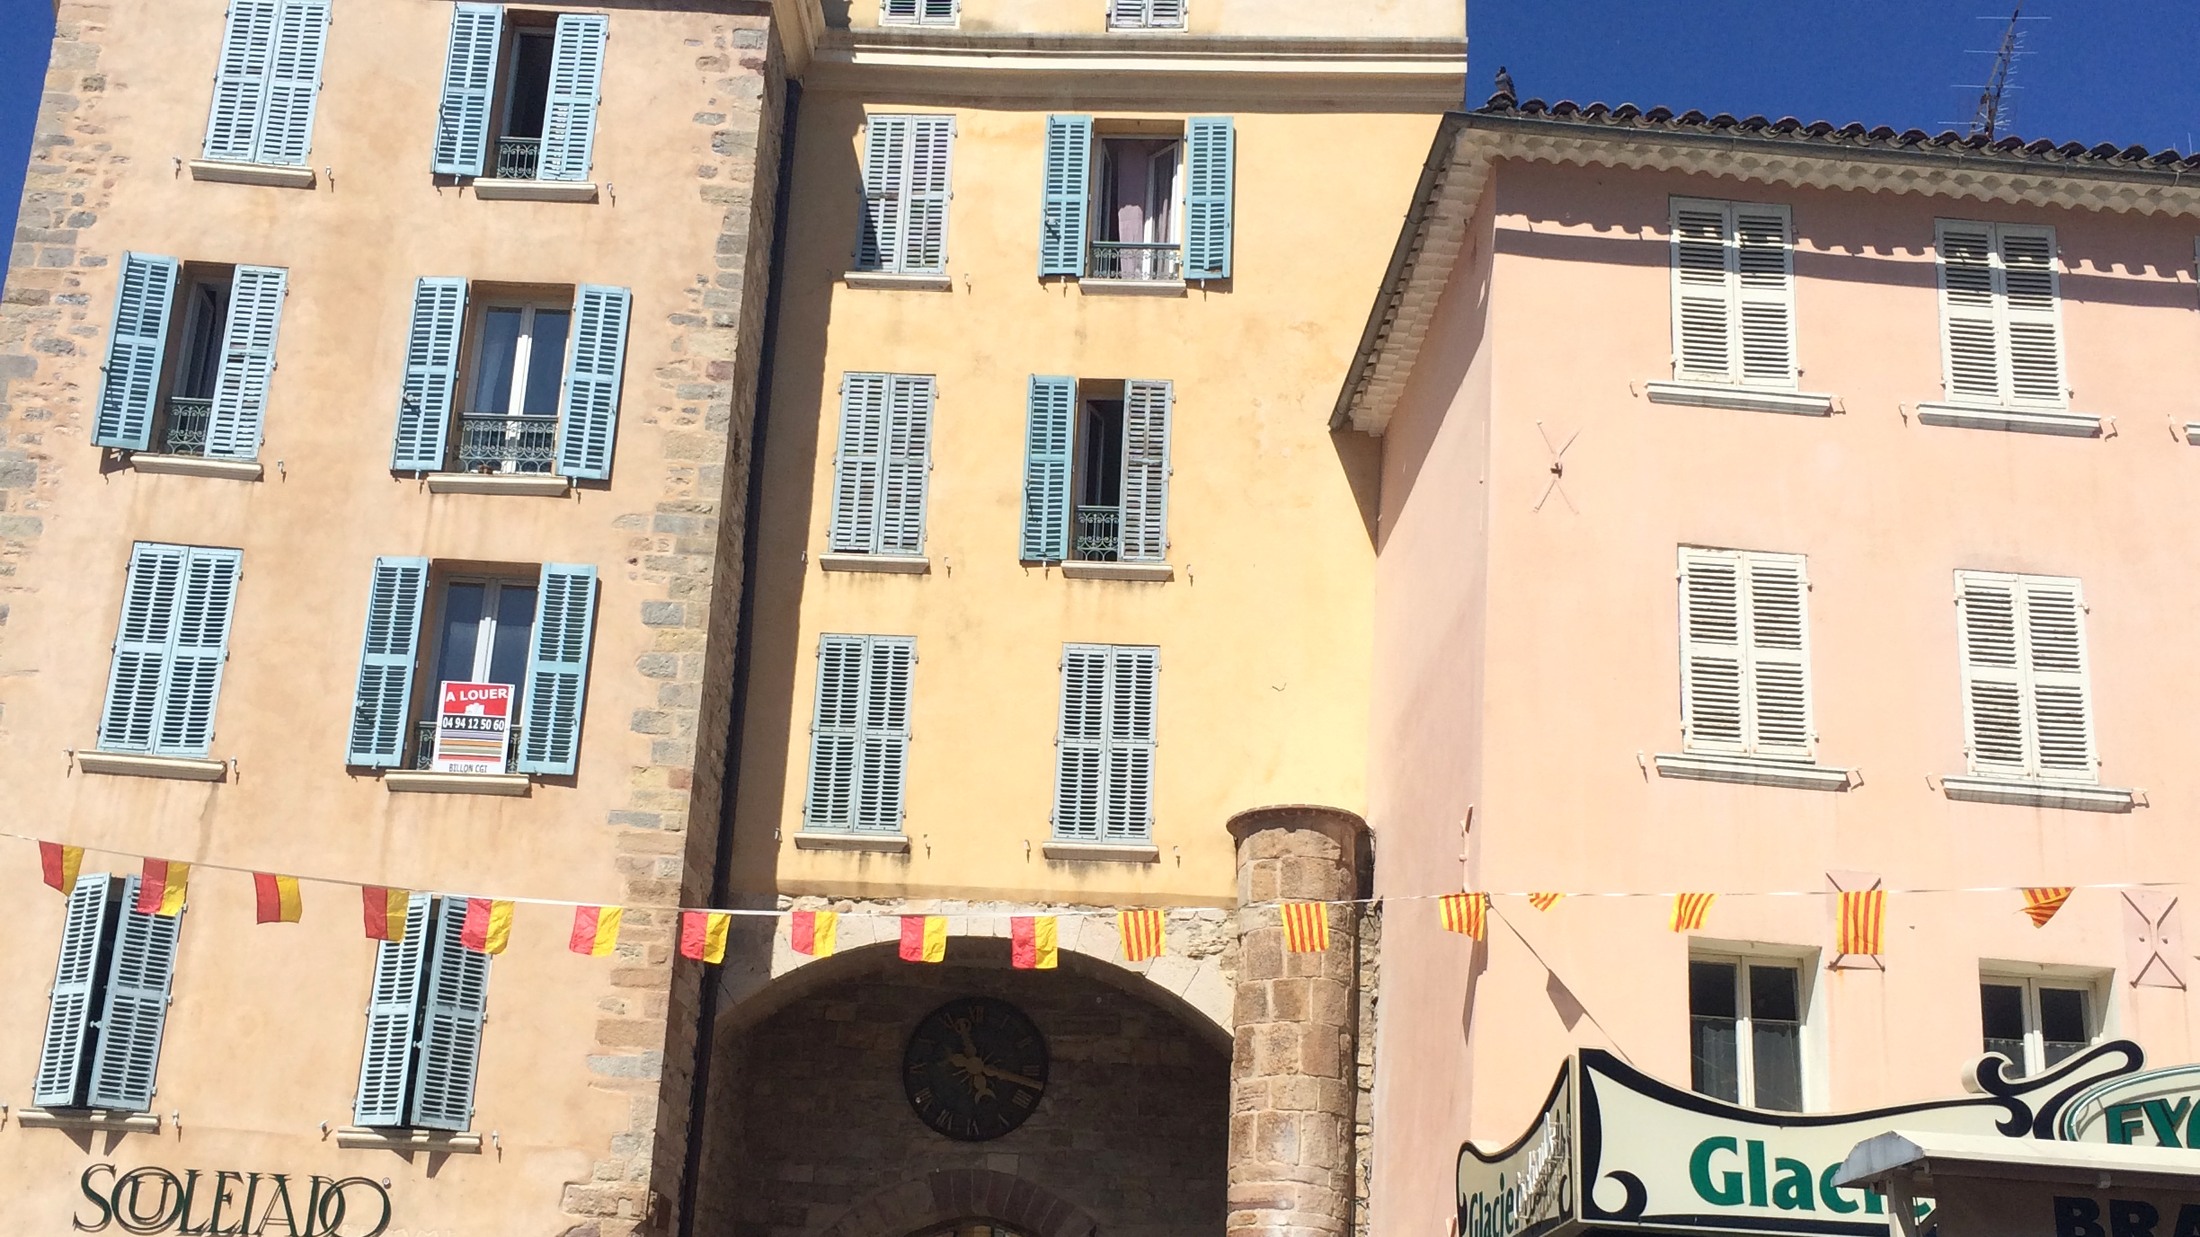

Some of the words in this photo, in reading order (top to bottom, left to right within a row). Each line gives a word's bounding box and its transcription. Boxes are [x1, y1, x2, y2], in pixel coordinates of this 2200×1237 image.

[445, 691, 456, 702] A
[460, 688, 508, 701] LOUER
[442, 717, 454, 729] 04
[455, 717, 466, 729] 94
[468, 718, 479, 729] 12
[480, 719, 491, 730] 50
[493, 720, 505, 731] 60
[449, 763, 474, 773] BILLON
